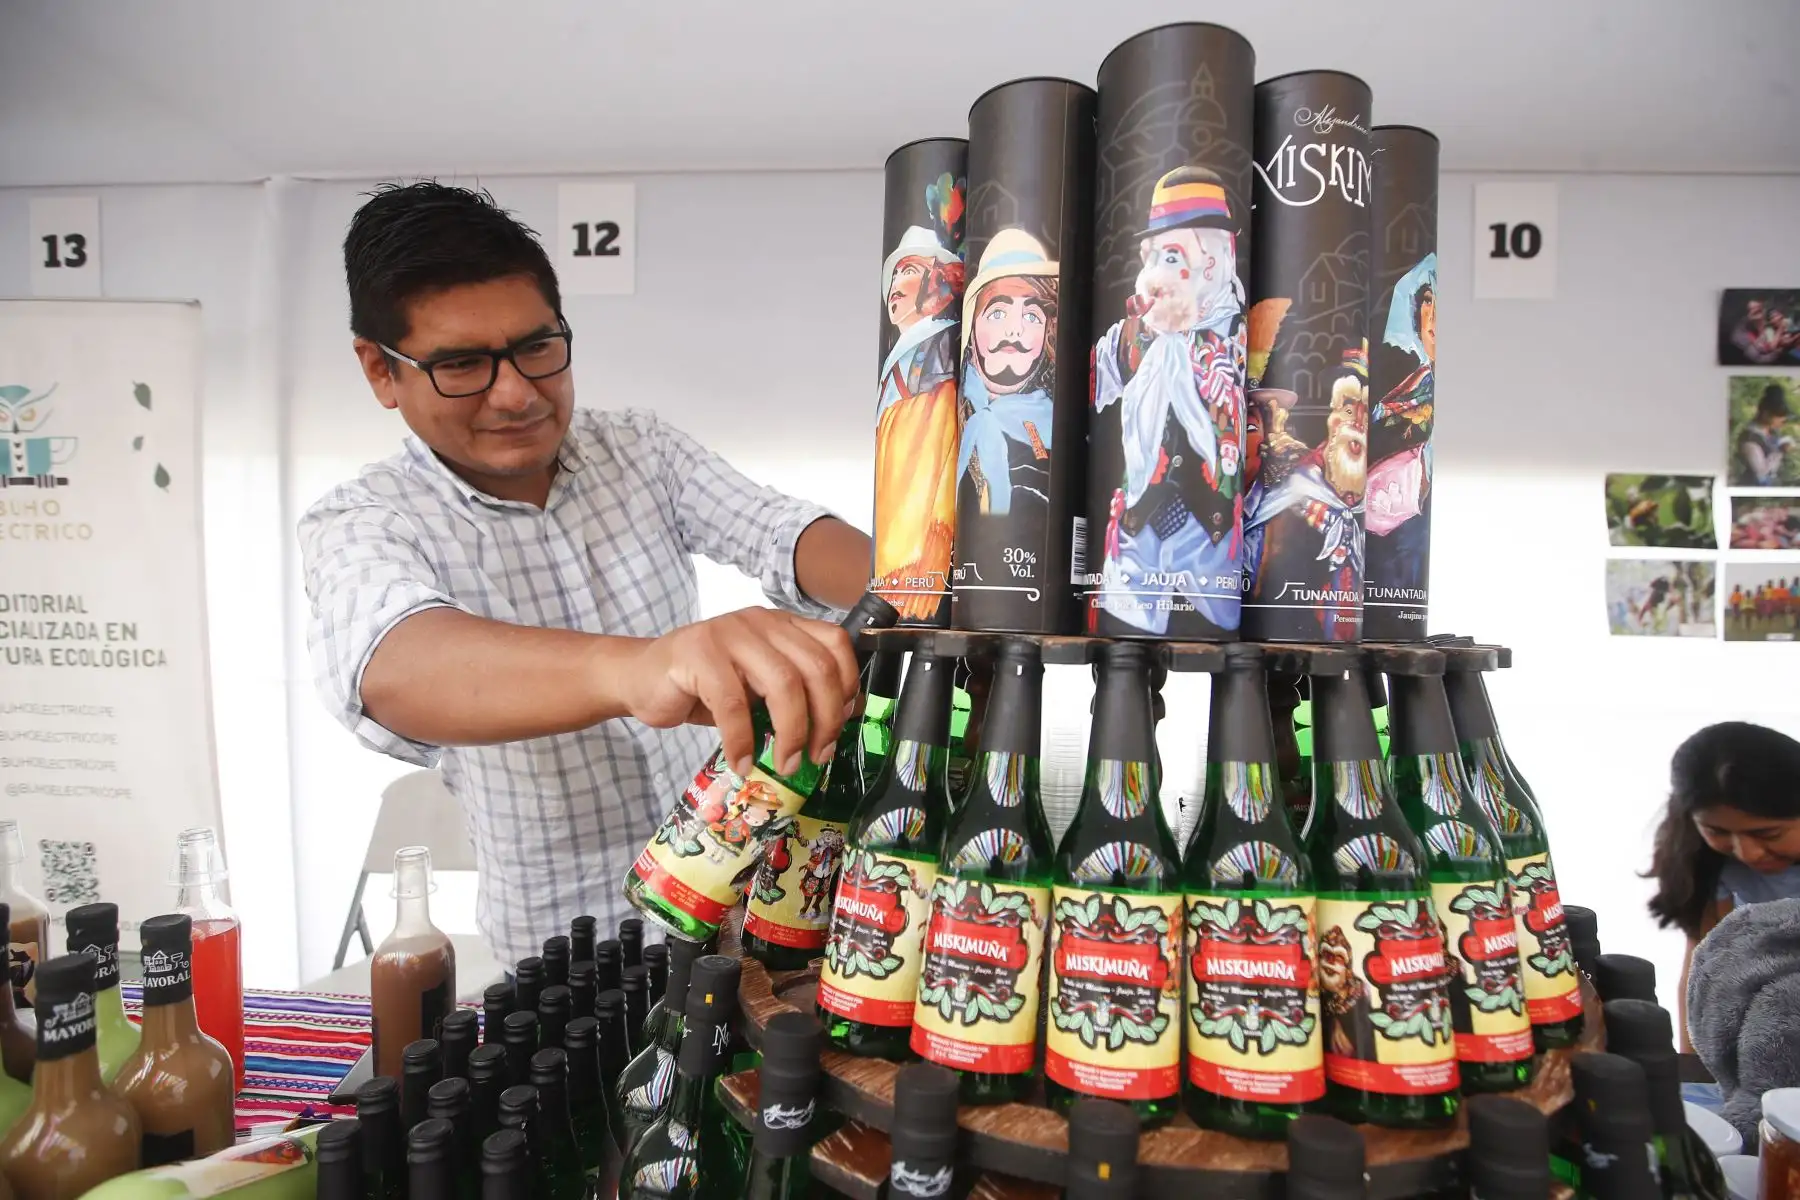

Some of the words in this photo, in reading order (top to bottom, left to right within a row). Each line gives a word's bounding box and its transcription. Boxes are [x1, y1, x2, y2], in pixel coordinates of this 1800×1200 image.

[572, 220, 620, 257] 12
[1489, 222, 1542, 259] 10
[42, 233, 87, 268] 13
[1003, 548, 1036, 564] 30%
[1009, 564, 1035, 578] Vol.
[1140, 572, 1187, 587] JAUJA
[905, 576, 935, 588] PERÚ
[1292, 589, 1359, 603] TUNANTADA
[1367, 587, 1427, 601] TUNANTADA
[1156, 599, 1195, 612] Hilario
[106, 621, 138, 641] EN
[50, 644, 168, 668] ECOLÓGICA
[933, 932, 1008, 962] MISKIMUÑA
[1065, 953, 1149, 981] MISKIMUÑA
[1206, 956, 1296, 981] MISKIMUÑA
